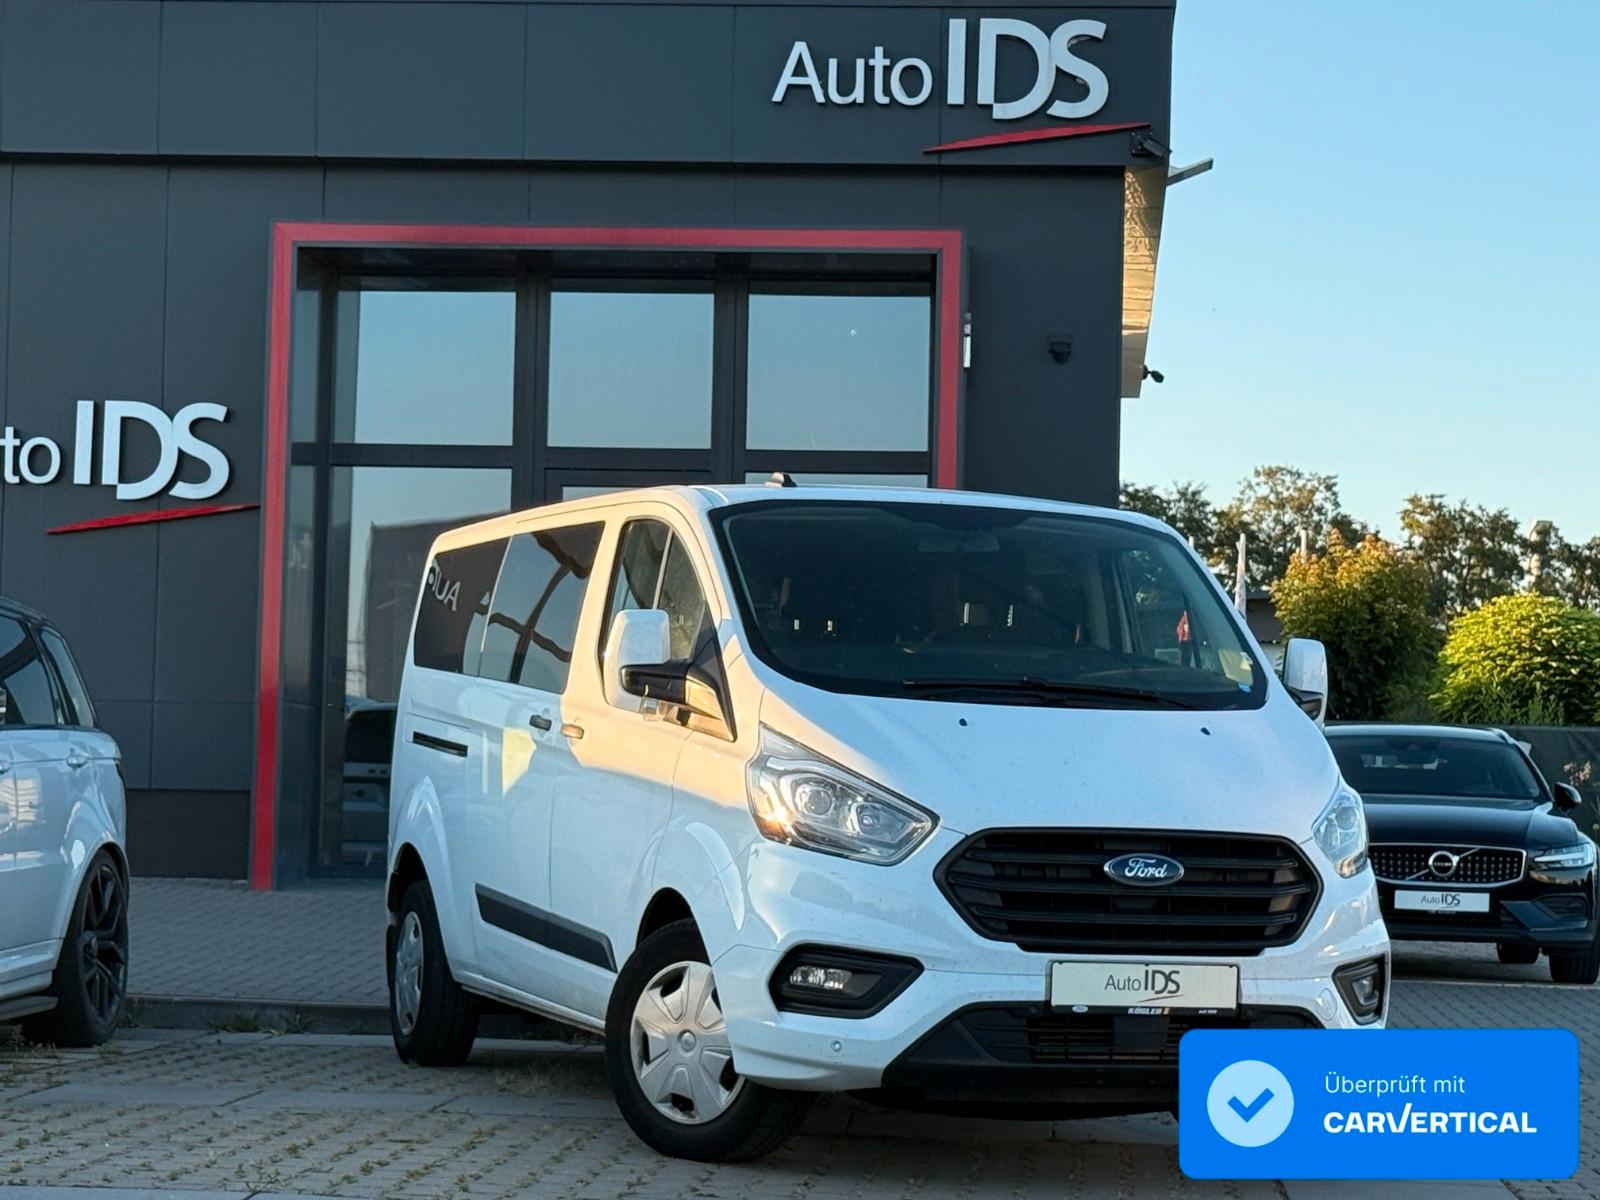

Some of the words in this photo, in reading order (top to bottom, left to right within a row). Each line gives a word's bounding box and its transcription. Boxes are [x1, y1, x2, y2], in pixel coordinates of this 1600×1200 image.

[771, 41, 932, 106] Auto
[947, 18, 1109, 120] IDS
[73, 400, 229, 500] IDS
[1124, 857, 1167, 878] Ford
[1421, 895, 1440, 904] Auto
[1441, 893, 1461, 906] IDS
[1104, 974, 1141, 991] Auto
[1144, 968, 1180, 994] IDS
